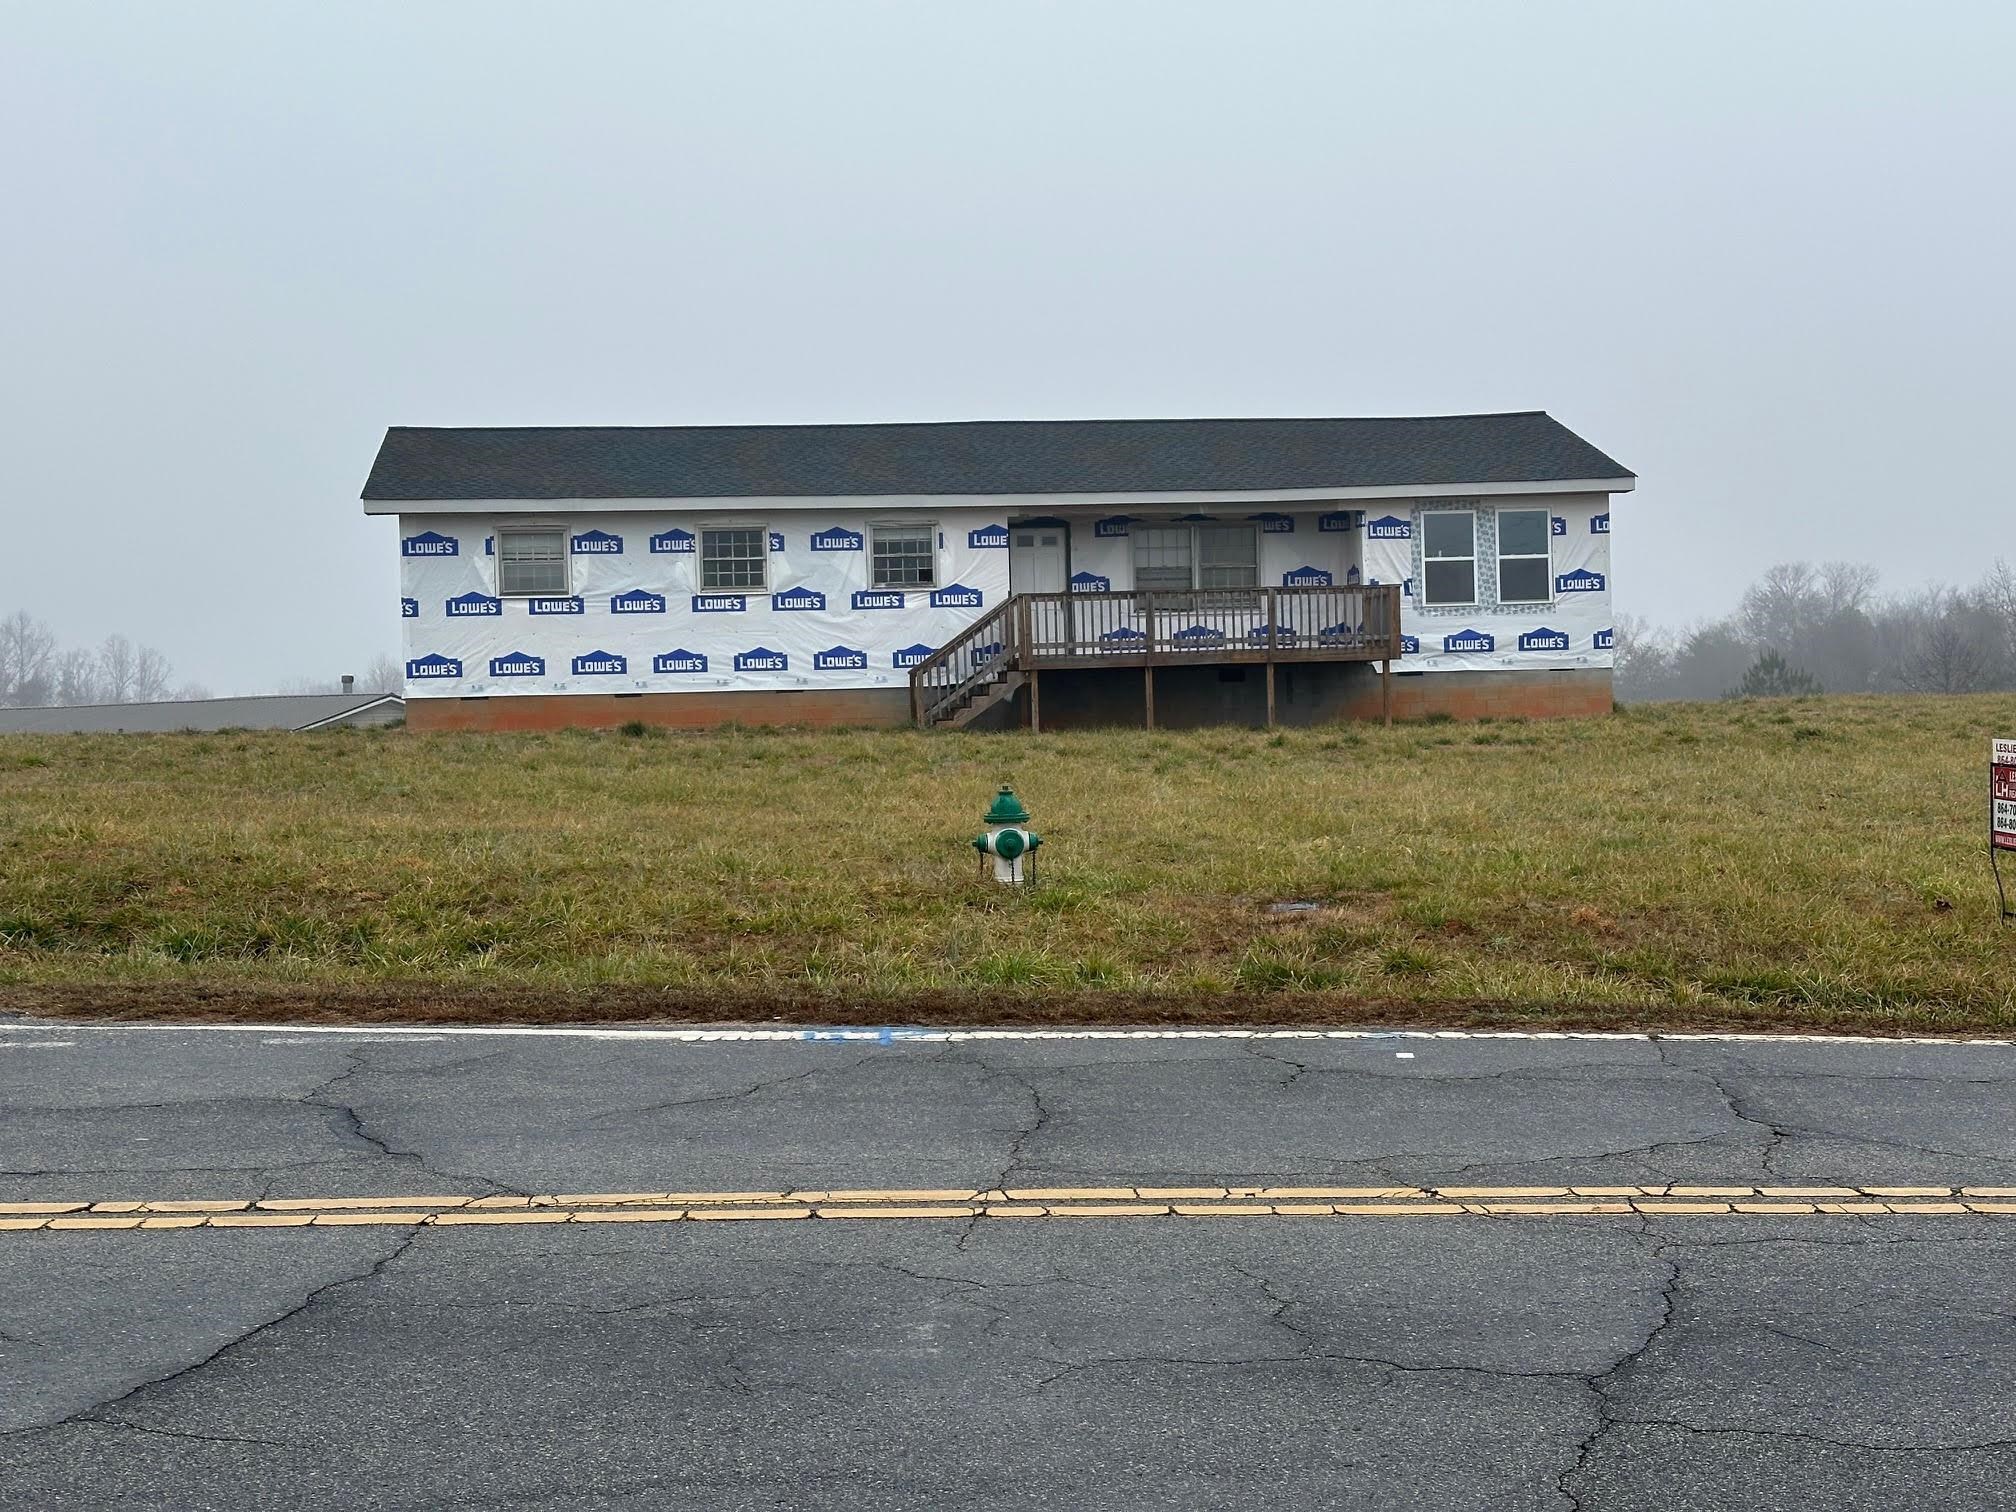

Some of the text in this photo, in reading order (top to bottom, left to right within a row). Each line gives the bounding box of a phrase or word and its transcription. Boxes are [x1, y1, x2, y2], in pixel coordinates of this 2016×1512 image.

[1369, 525, 1410, 537] LOWE'S
[408, 541, 453, 554] LOWE'S
[574, 538, 618, 552] LOWE'S
[816, 536, 859, 549] LOWE'S
[1072, 579, 1105, 592] OWE'S
[1287, 574, 1328, 586] LOWE'S
[1561, 578, 1600, 591] LOWE'S
[617, 597, 660, 611] LOWE'S
[697, 597, 741, 610] LOWE'S
[777, 595, 820, 608] LOWE'S
[857, 594, 900, 607] LOWE'S
[936, 592, 977, 605] LOWE'S
[452, 600, 496, 614] LOWE'S
[535, 599, 579, 612] LOWE'S
[1449, 638, 1490, 651] LOWE'S
[1524, 637, 1564, 650] LOWE'S
[496, 661, 540, 674] LOWE'S
[578, 660, 621, 672] LOWE'S
[659, 658, 702, 671] LOWE'S
[739, 657, 783, 670] LOWE'S
[819, 655, 862, 668] LOWE'S
[412, 663, 457, 676] LOWE'S
